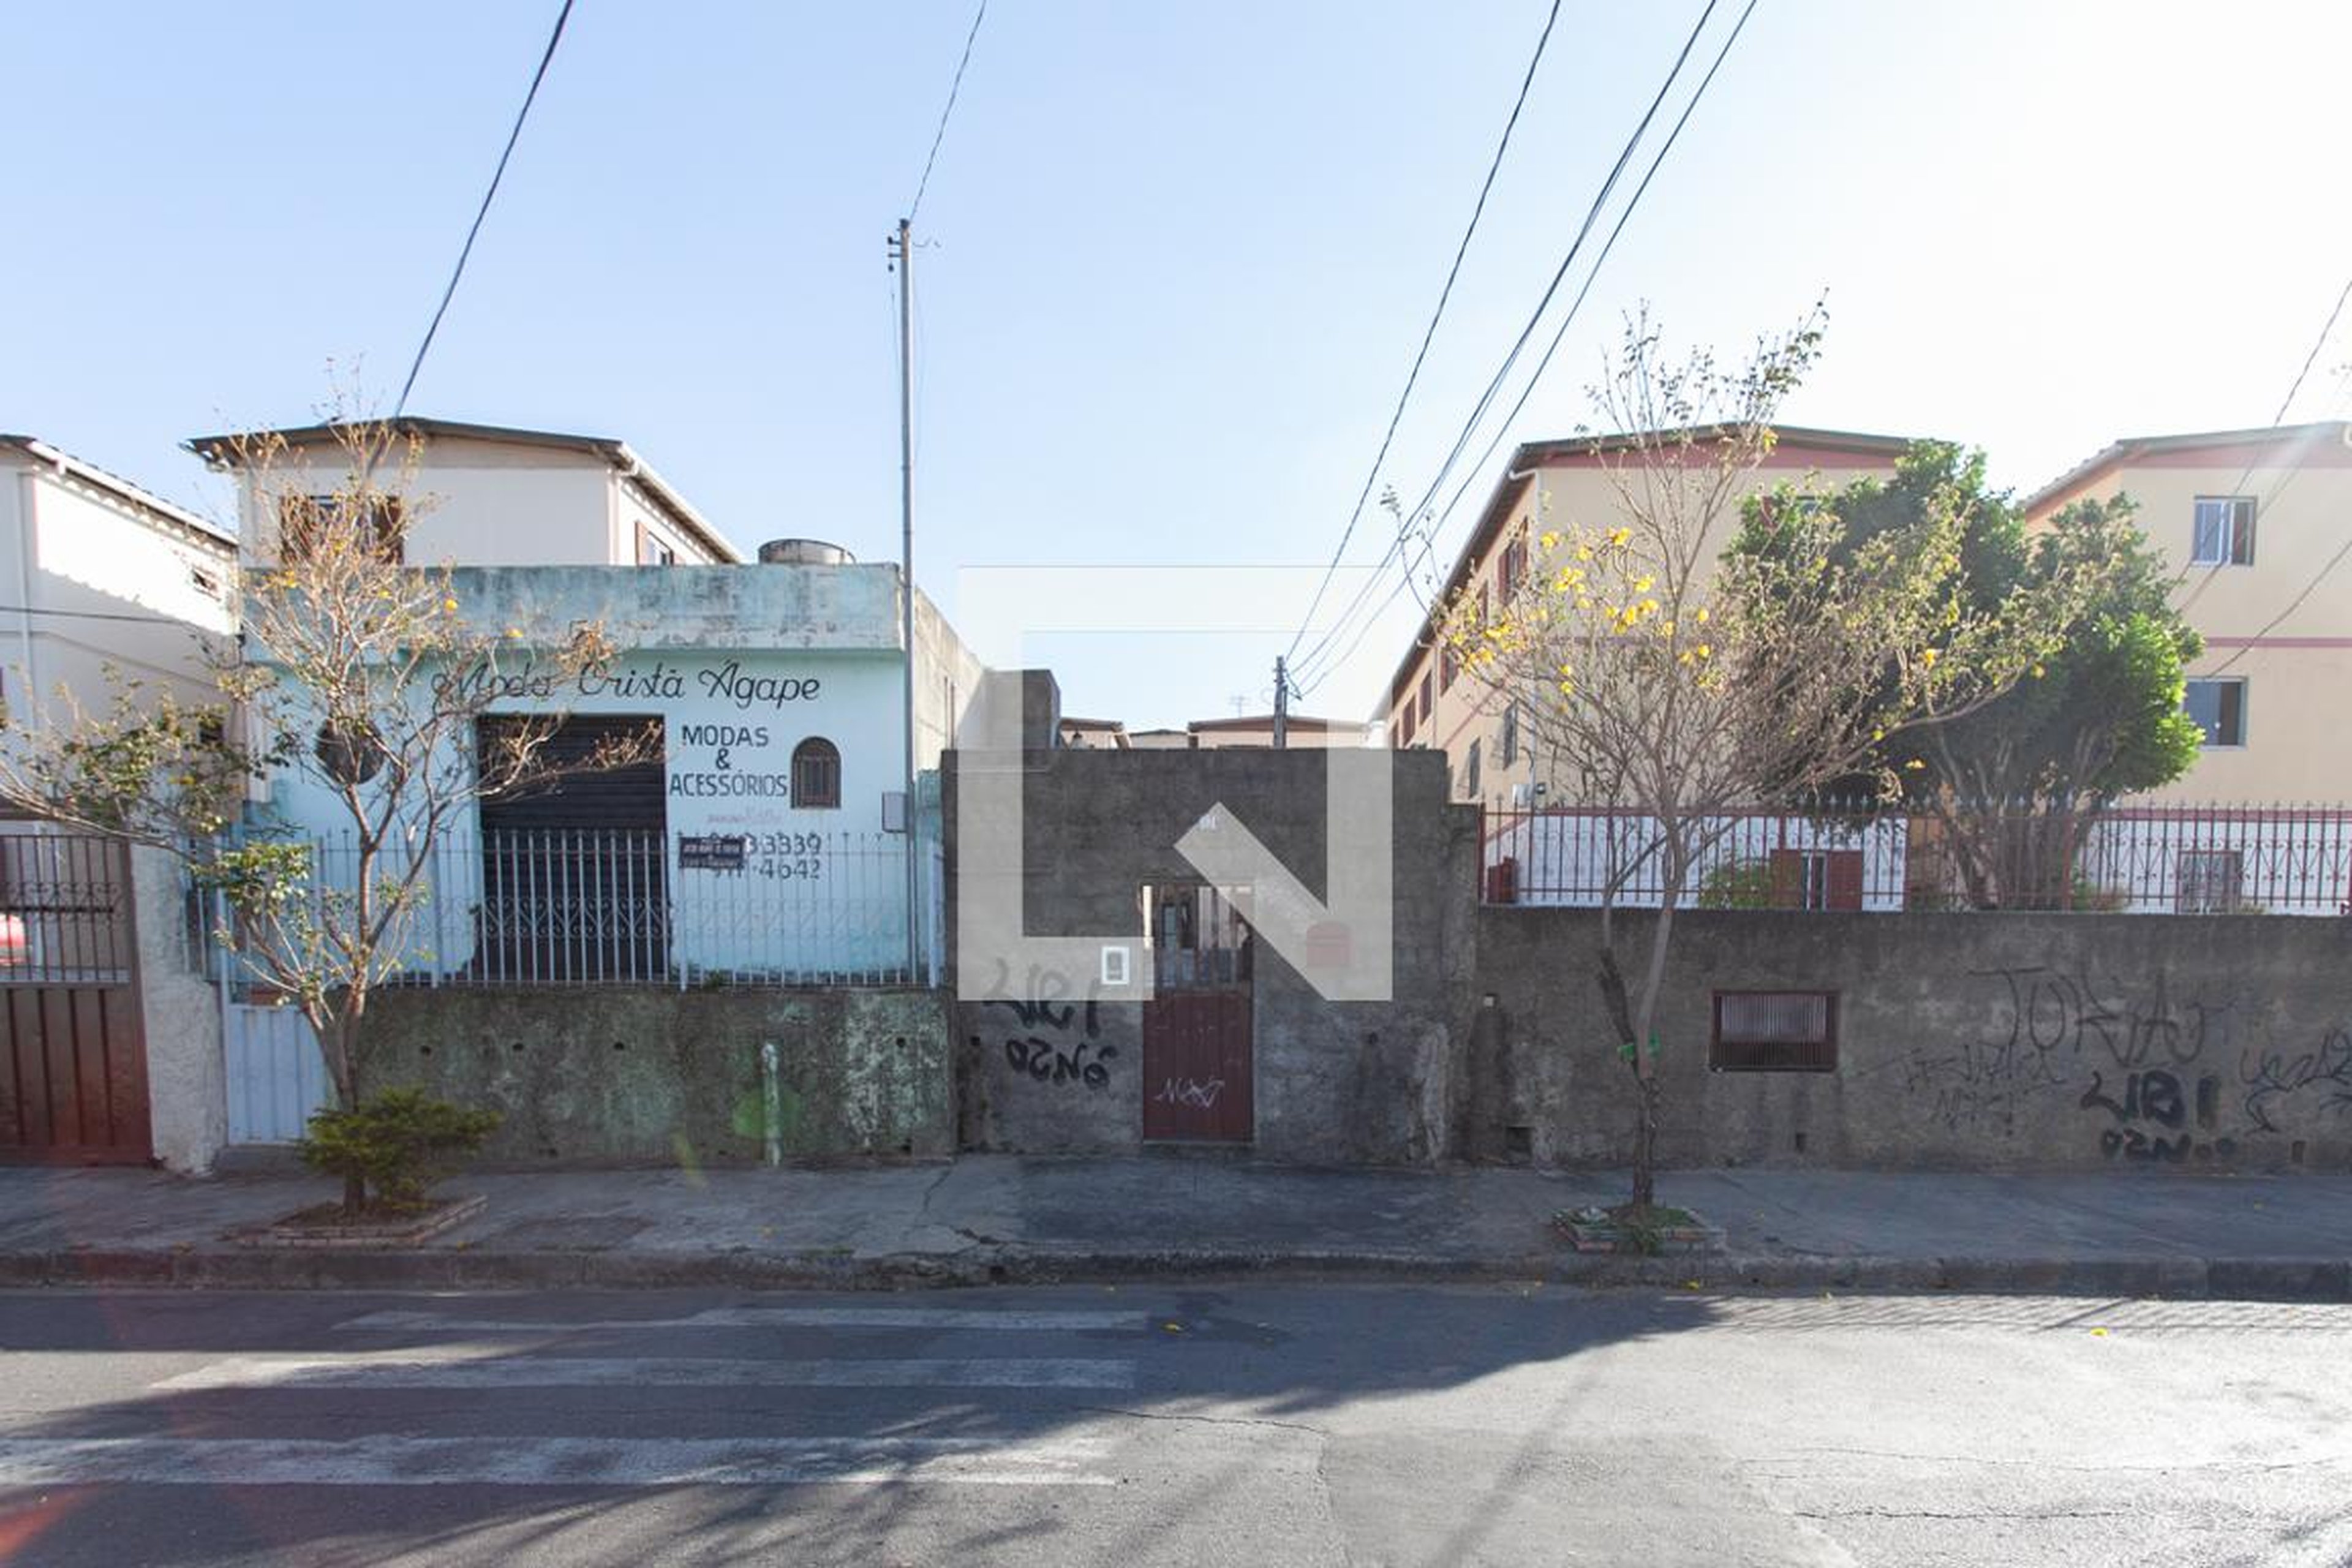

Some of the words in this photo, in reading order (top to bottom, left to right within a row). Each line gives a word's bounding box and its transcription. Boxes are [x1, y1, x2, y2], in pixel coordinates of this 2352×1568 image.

[698, 658, 821, 710] Ágape
[681, 725, 769, 747] MODAS
[715, 747, 731, 771] &
[669, 769, 788, 797] ACESSÓRIOS
